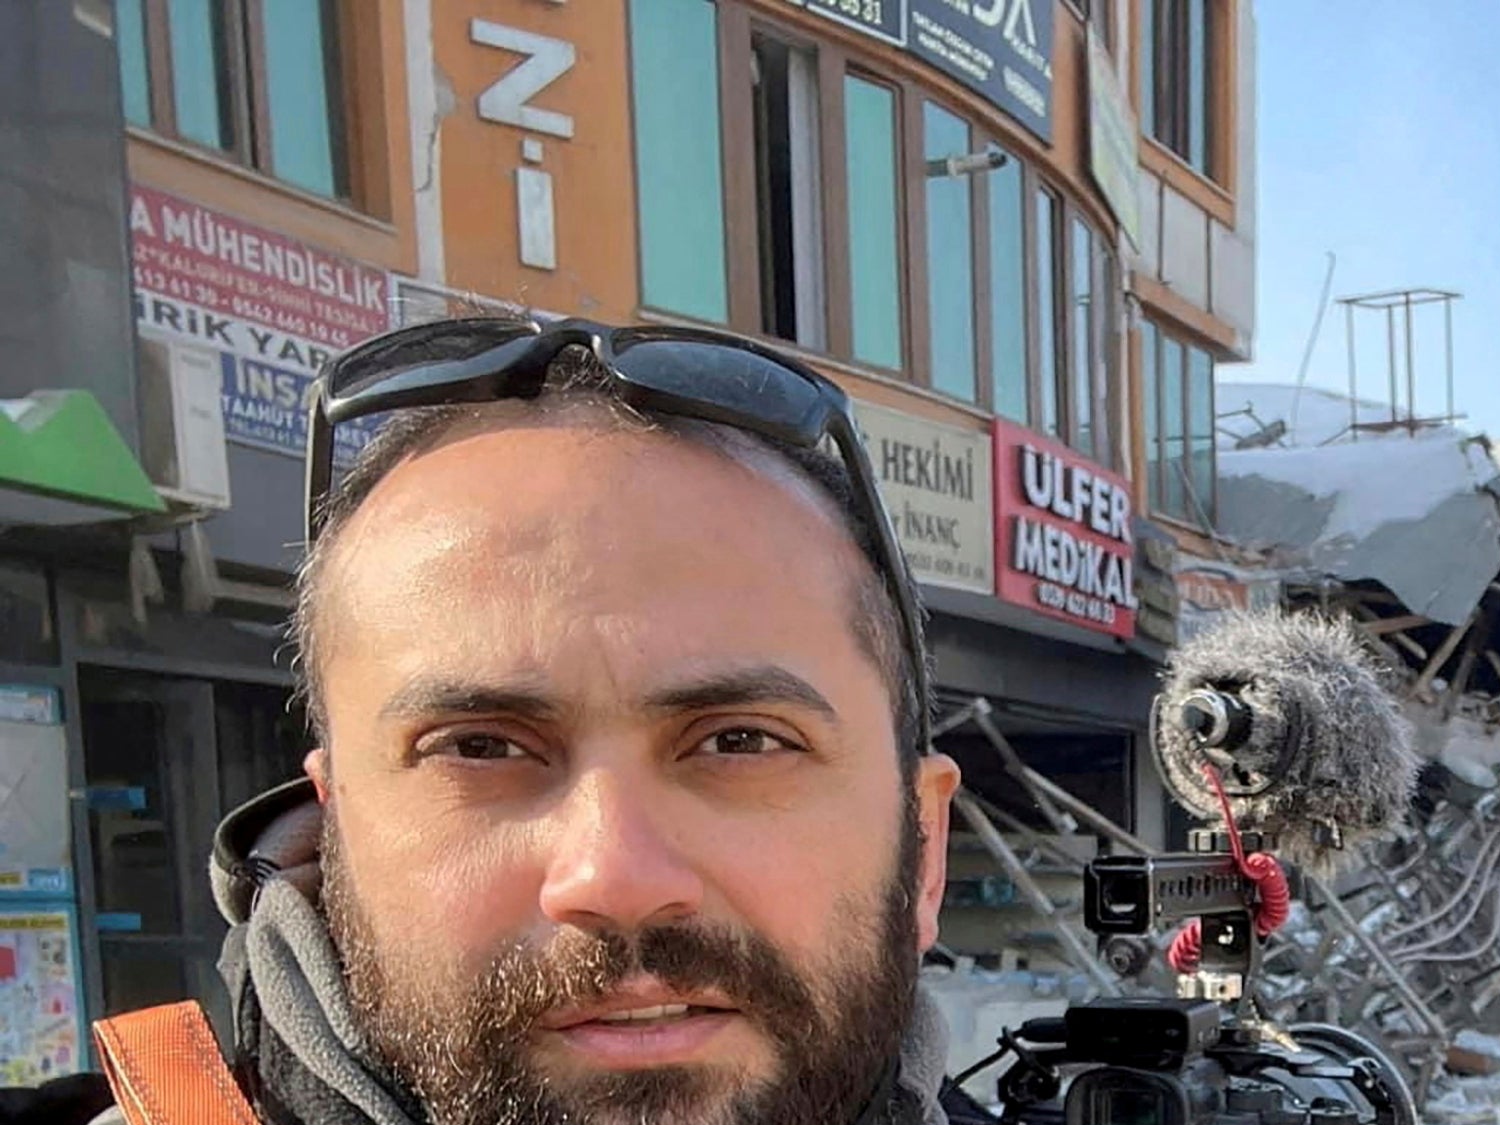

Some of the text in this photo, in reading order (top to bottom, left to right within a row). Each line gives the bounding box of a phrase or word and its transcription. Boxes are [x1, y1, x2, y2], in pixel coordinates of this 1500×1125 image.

[161, 203, 386, 314] MÜHENDİSLİK
[881, 437, 975, 502] HEKİMİ
[1023, 443, 1132, 545] ÜLFER
